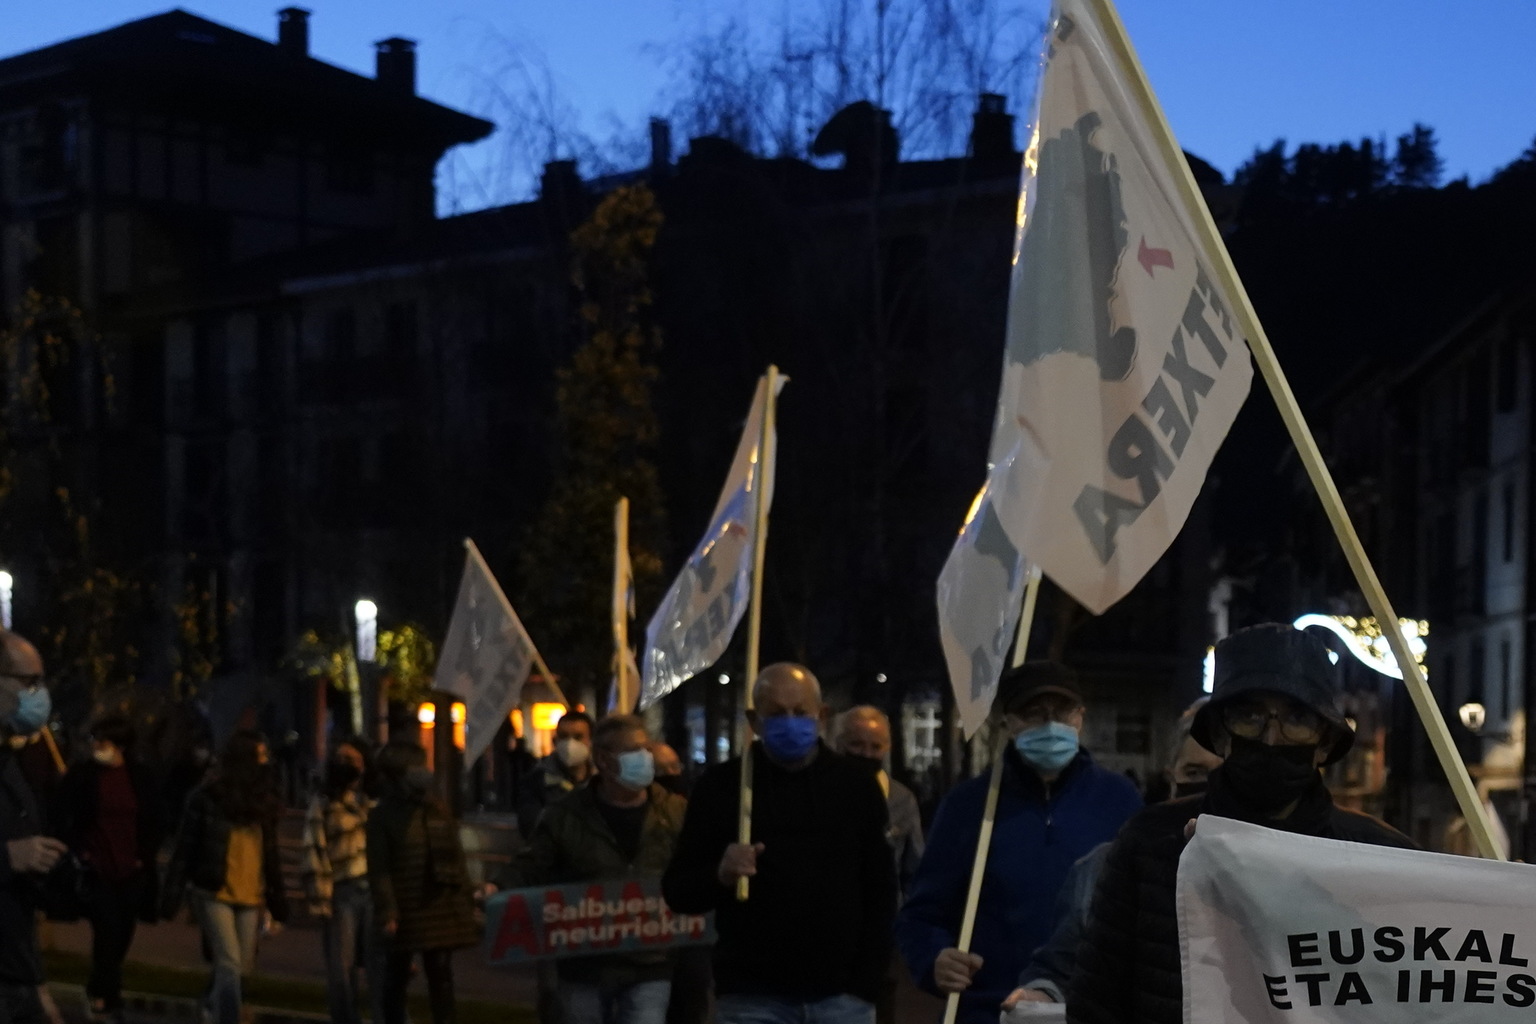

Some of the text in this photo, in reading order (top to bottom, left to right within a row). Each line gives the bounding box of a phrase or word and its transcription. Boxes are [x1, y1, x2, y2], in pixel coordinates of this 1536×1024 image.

[549, 912, 706, 947] neurriekin
[1287, 925, 1530, 968] EUSKAL
[1263, 972, 1373, 1010] ETA
